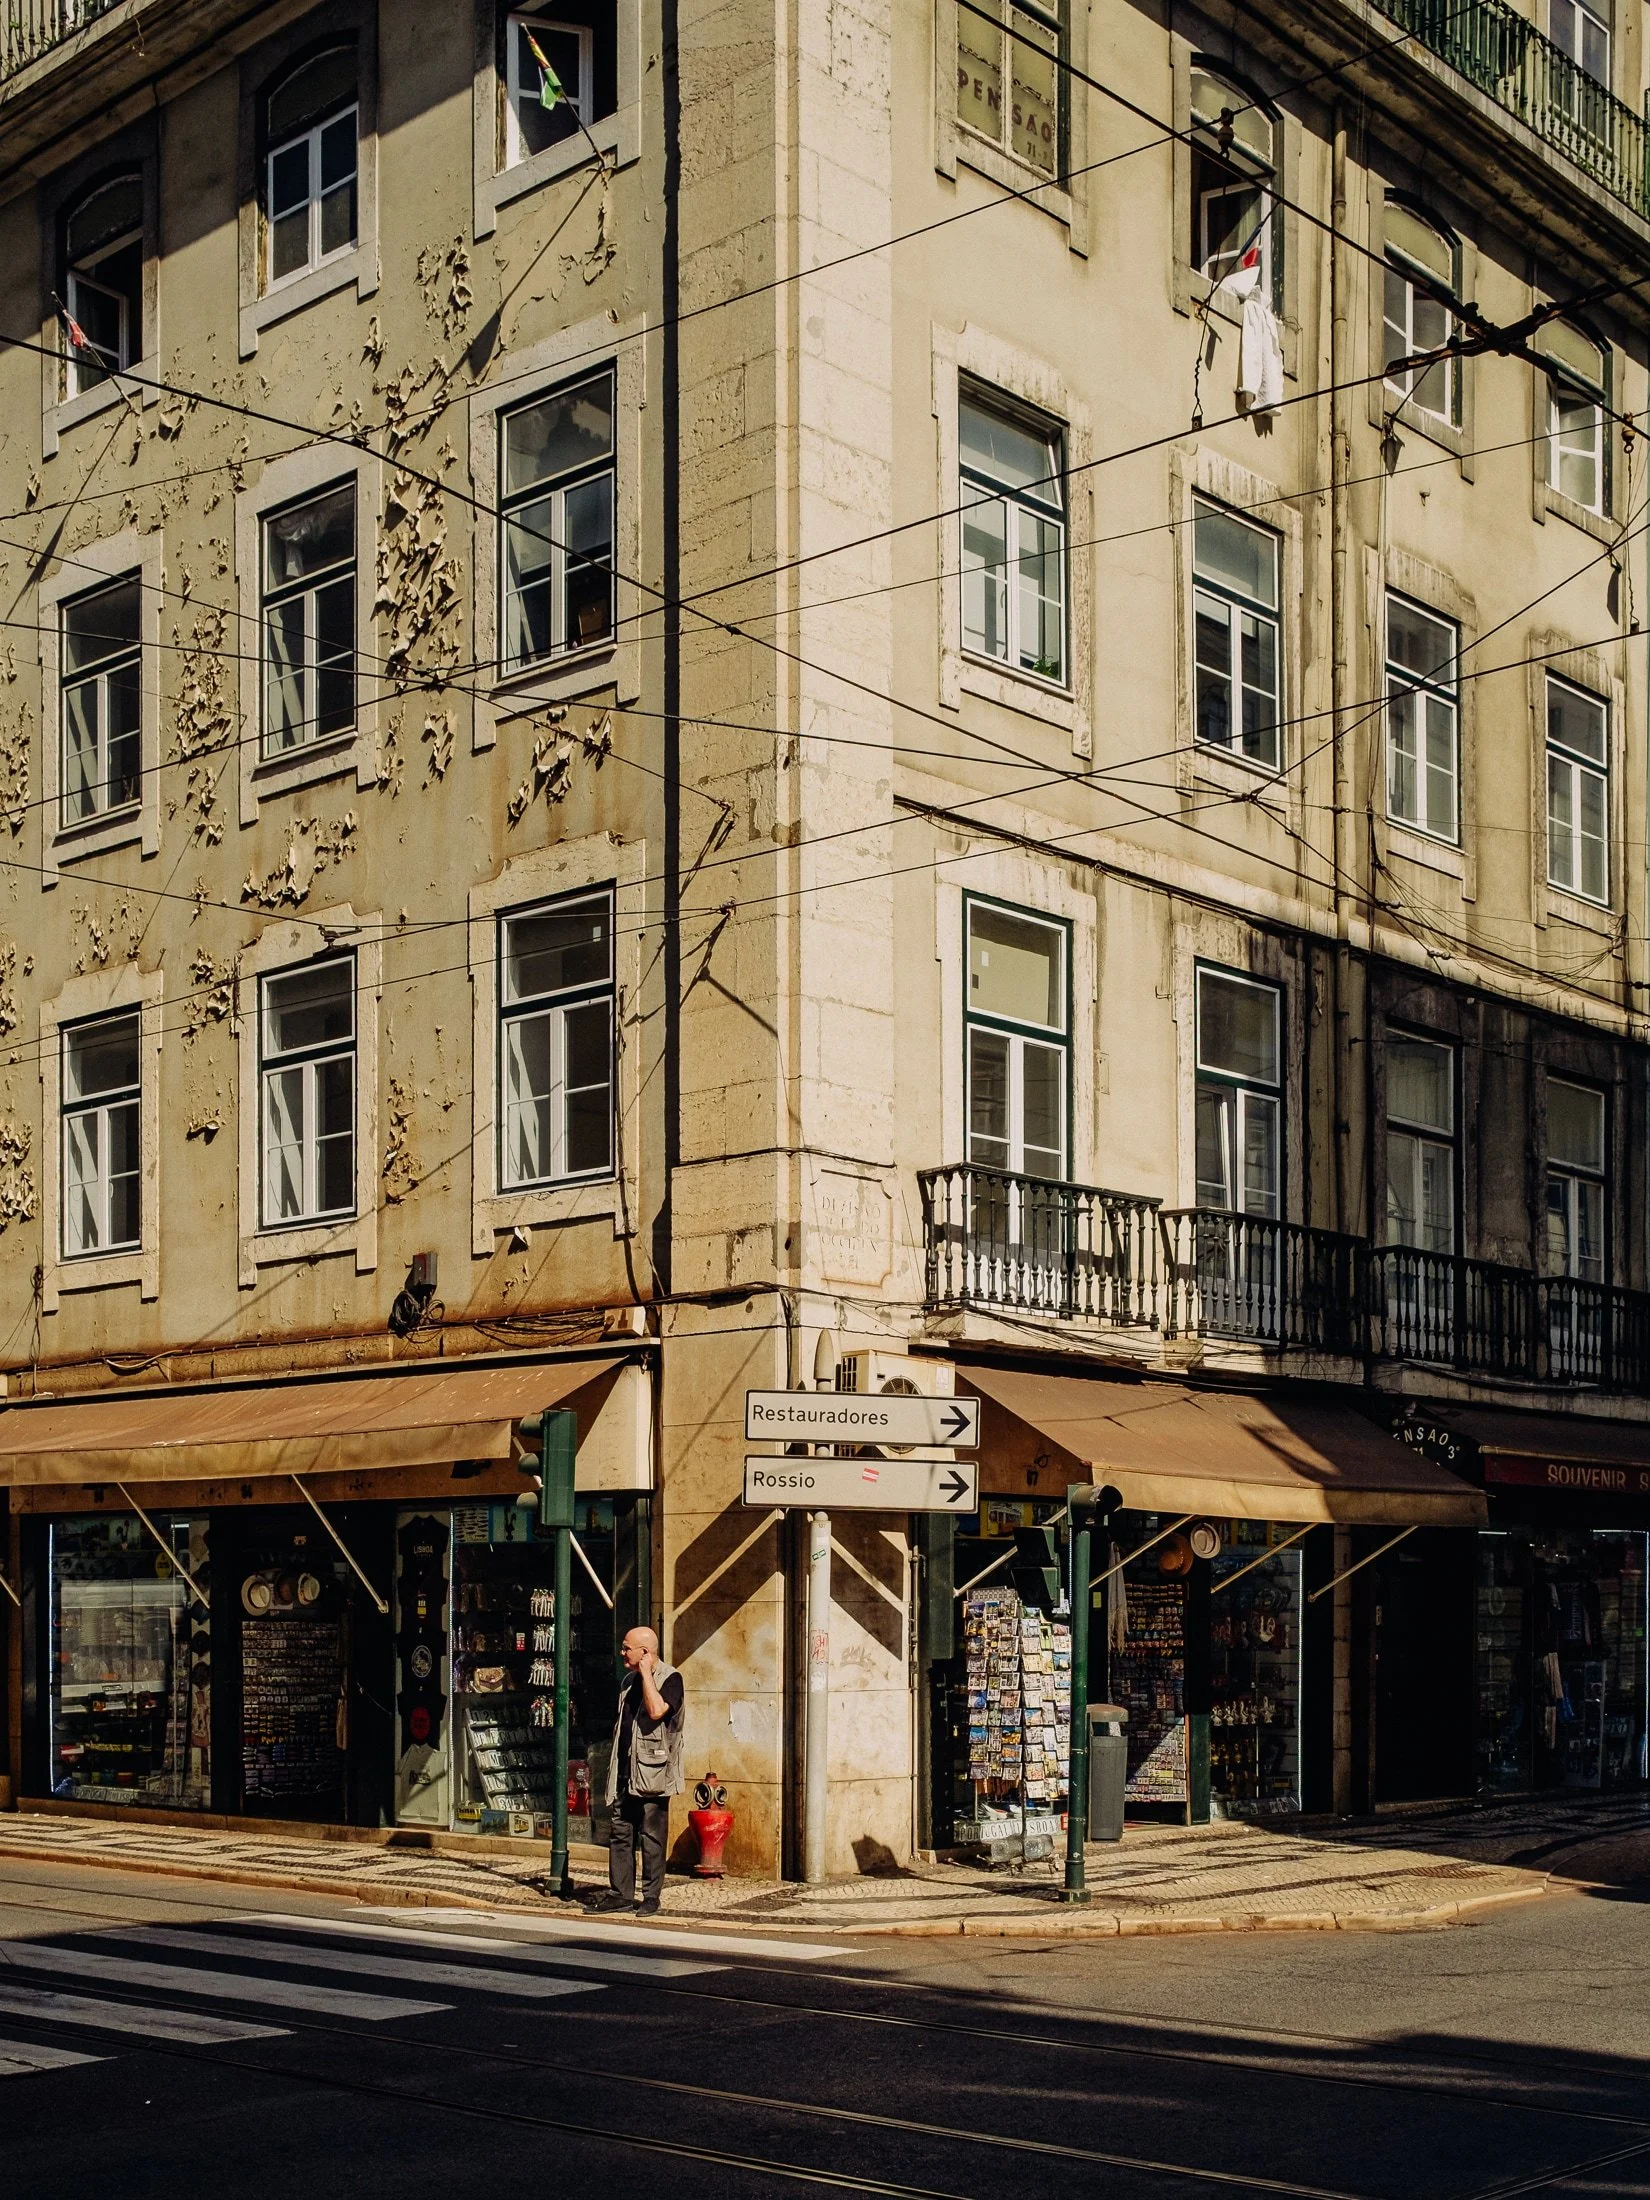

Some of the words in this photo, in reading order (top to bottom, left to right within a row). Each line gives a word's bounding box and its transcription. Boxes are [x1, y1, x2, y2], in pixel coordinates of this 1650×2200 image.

[752, 1404, 889, 1426] Restauradores
[753, 1471, 816, 1489] Rossio
[1547, 1463, 1626, 1490] SOUVENIR
